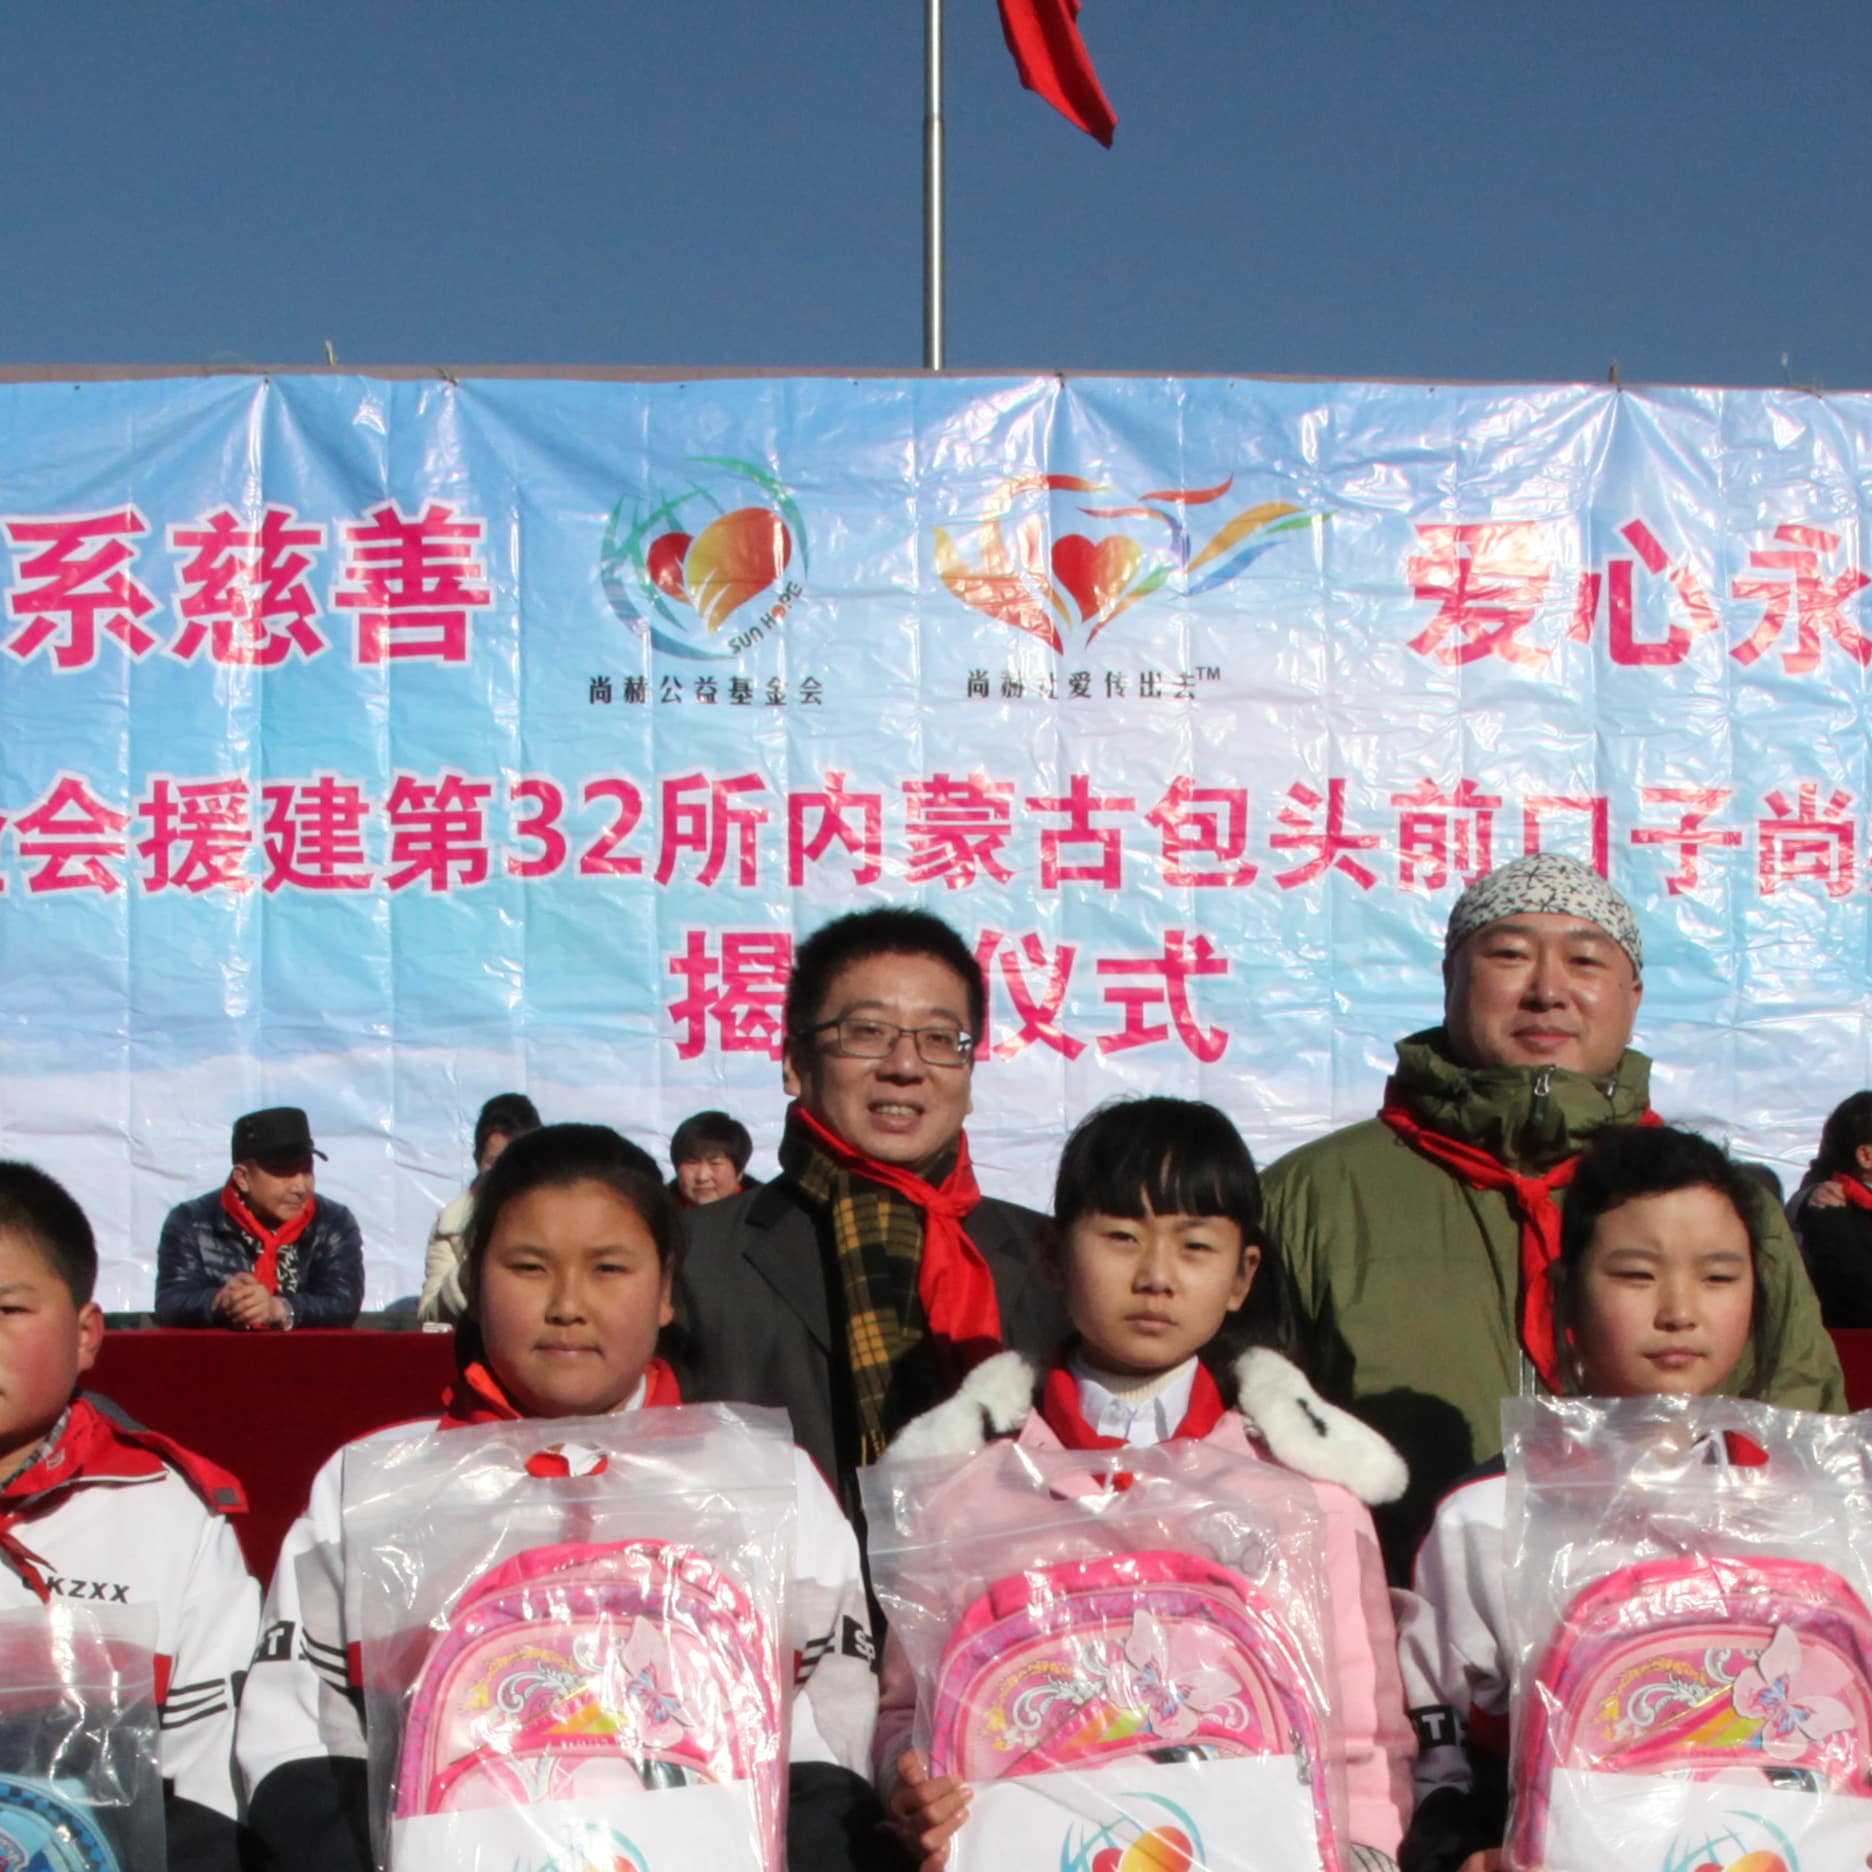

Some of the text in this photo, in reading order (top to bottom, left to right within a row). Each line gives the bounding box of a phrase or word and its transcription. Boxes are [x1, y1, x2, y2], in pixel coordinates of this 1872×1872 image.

[589, 675, 823, 706] 尚赫公益基金会
[669, 928, 1230, 1065] 揭仪式
